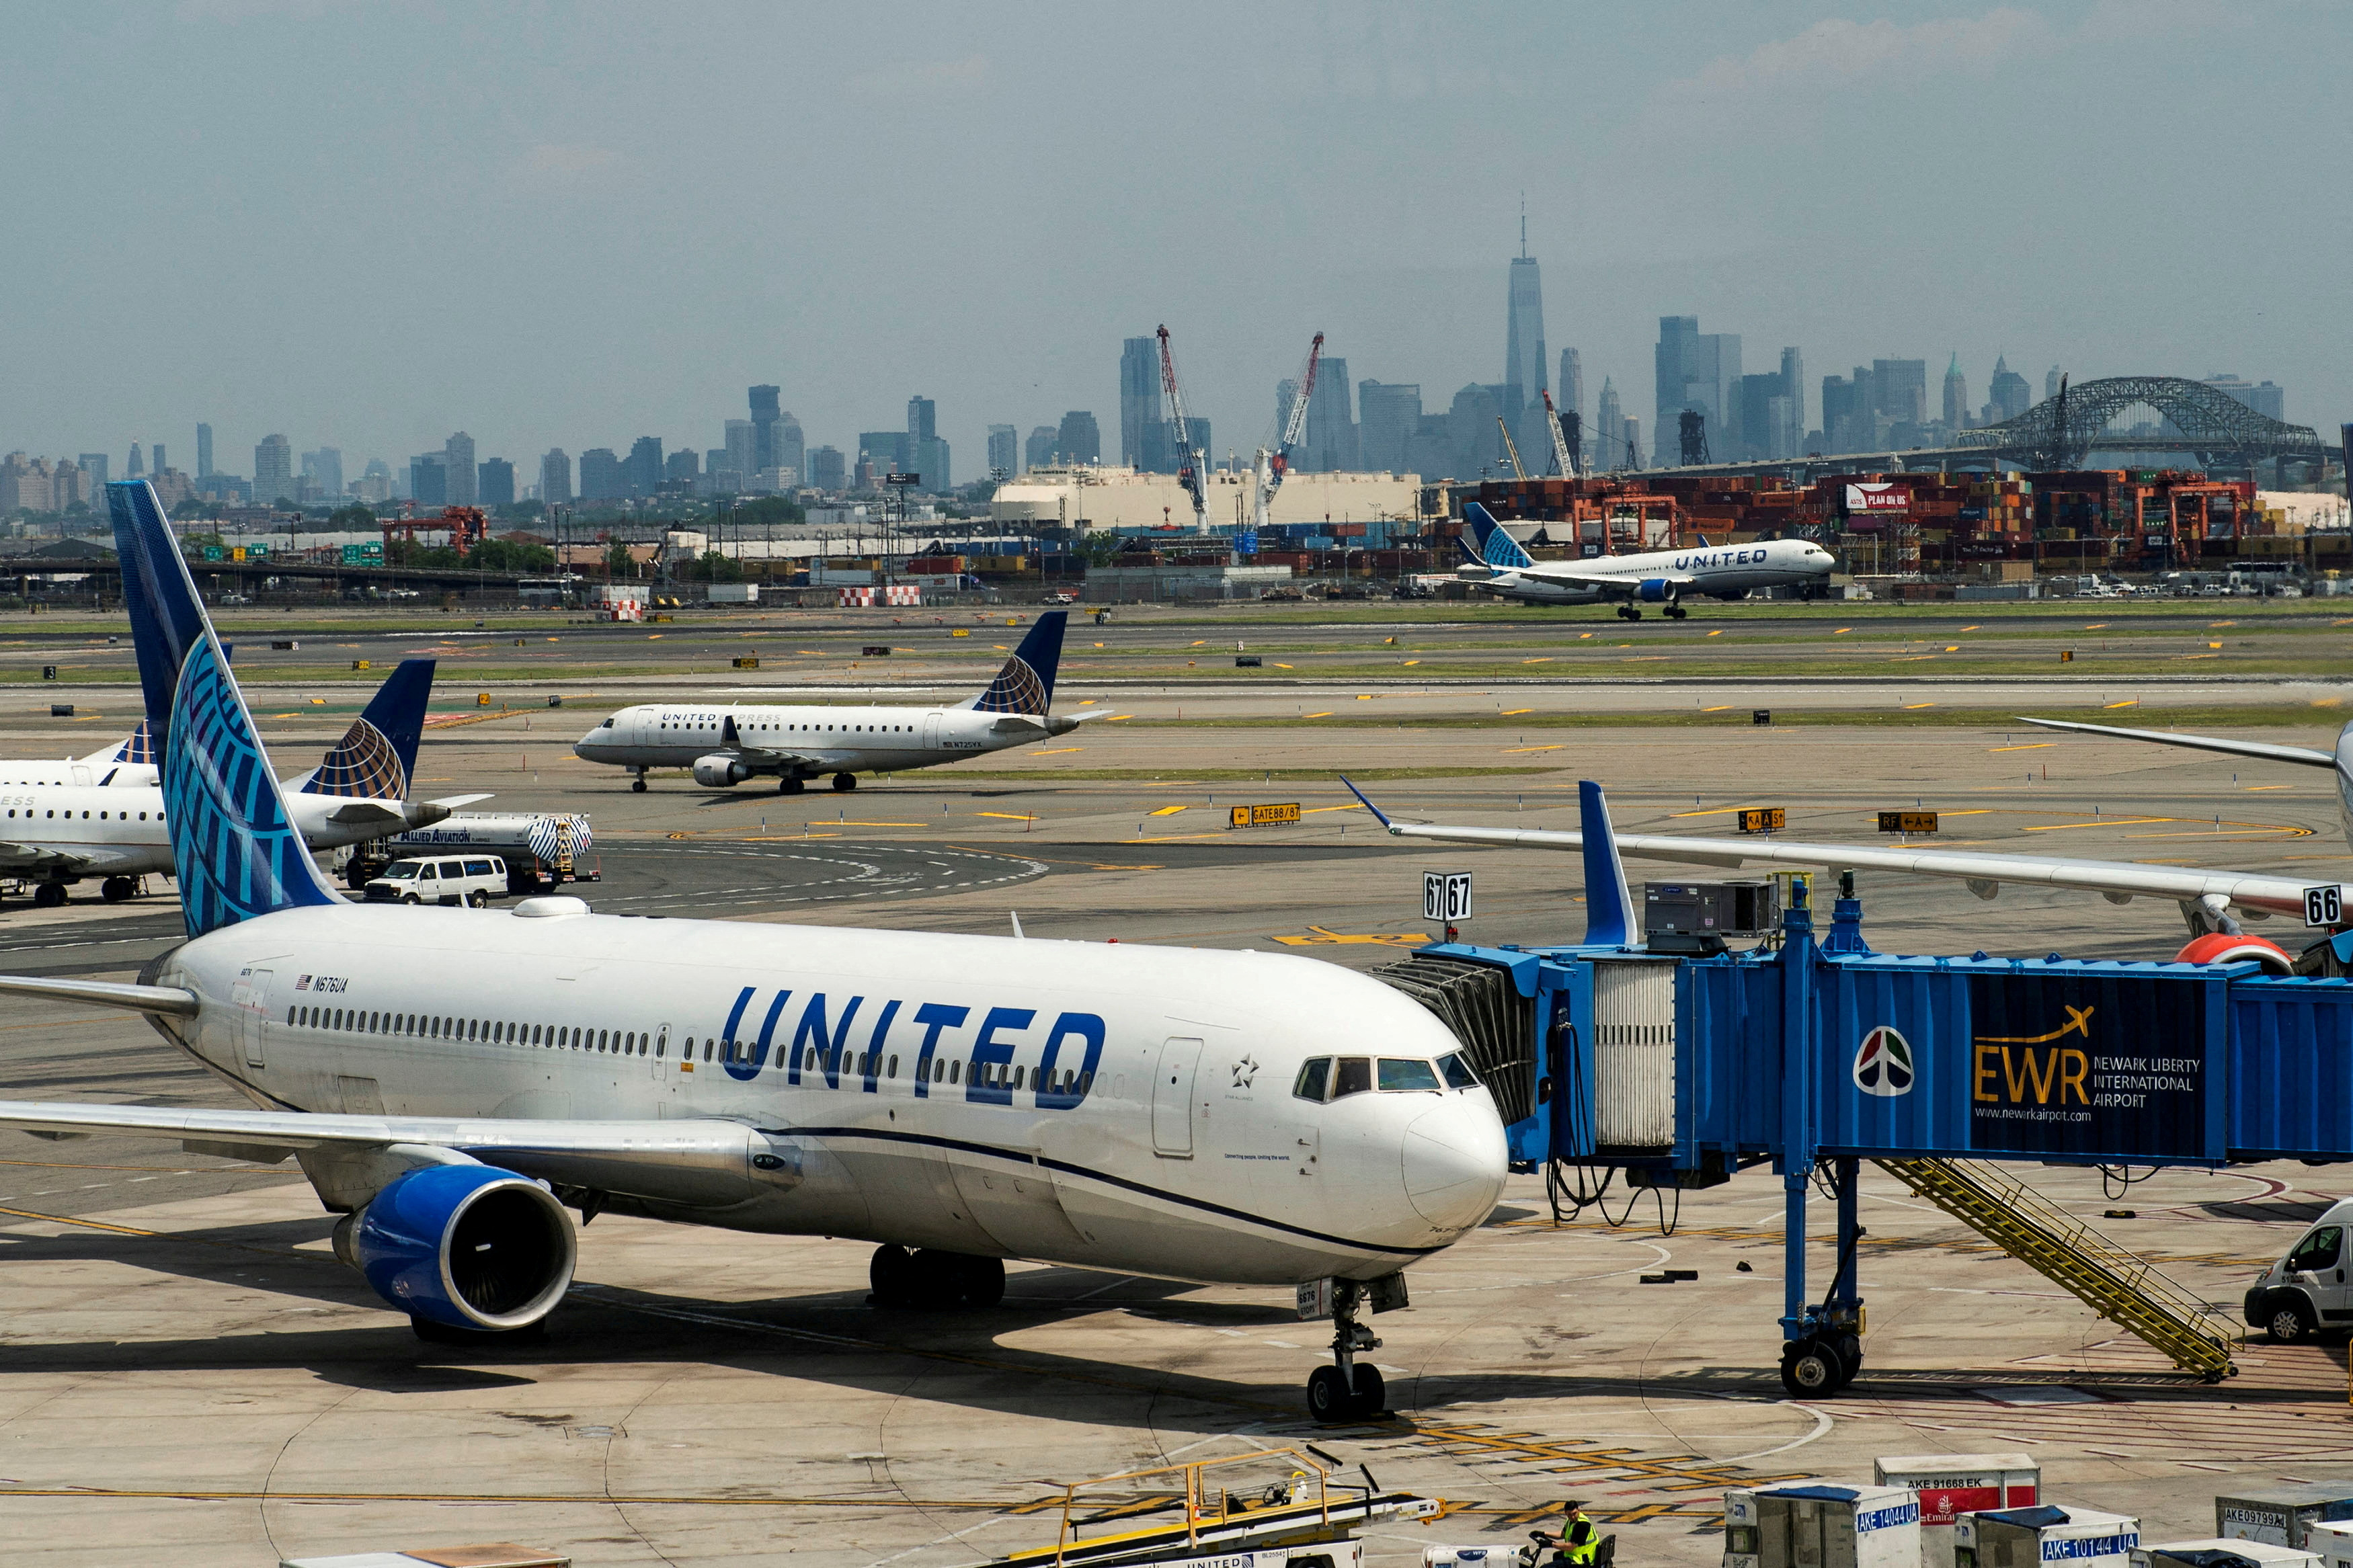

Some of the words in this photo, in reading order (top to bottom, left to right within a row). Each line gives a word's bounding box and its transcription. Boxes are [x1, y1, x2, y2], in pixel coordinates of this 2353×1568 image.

[1868, 495, 1885, 505] PLAN
[1886, 495, 1896, 505] ON
[1897, 495, 1906, 505] US
[1675, 549, 1767, 570] UNITED
[48, 667, 54, 679] 3
[718, 714, 781, 722] EPRESS
[1254, 807, 1300, 821] GATE88/87
[1754, 813, 1760, 825] A
[1764, 813, 1769, 824] A
[1773, 813, 1779, 824] S
[1884, 818, 1897, 828] RF
[1915, 818, 1922, 828] A
[401, 831, 430, 843] ALLIED
[432, 829, 471, 843] AVIATION
[1425, 876, 1443, 918] 67
[1447, 876, 1470, 915] 67
[2309, 889, 2339, 923] 66
[313, 976, 349, 993] N676UA
[721, 987, 1106, 1110] UNITED
[2094, 1056, 2147, 1072] NEWARK
[2151, 1058, 2200, 1073] LIBERTY
[1975, 1045, 2091, 1106] EWR
[2094, 1075, 2193, 1091] INTERNATIONAL
[2094, 1093, 2146, 1108] AIRPORT
[1975, 1107, 2091, 1123] www.newarkairport.com
[1299, 1290, 1315, 1304] 6676
[1908, 1479, 1930, 1489] AKE
[1933, 1479, 1964, 1488] 91668
[1967, 1479, 1982, 1487] EK
[1860, 1514, 1878, 1531] AKE
[1879, 1508, 1905, 1527] 14044
[1905, 1504, 1917, 1522] UA
[2046, 1540, 2070, 1560] AKE
[2073, 1538, 2112, 1557] 10144
[2118, 1534, 2135, 1553] UA
